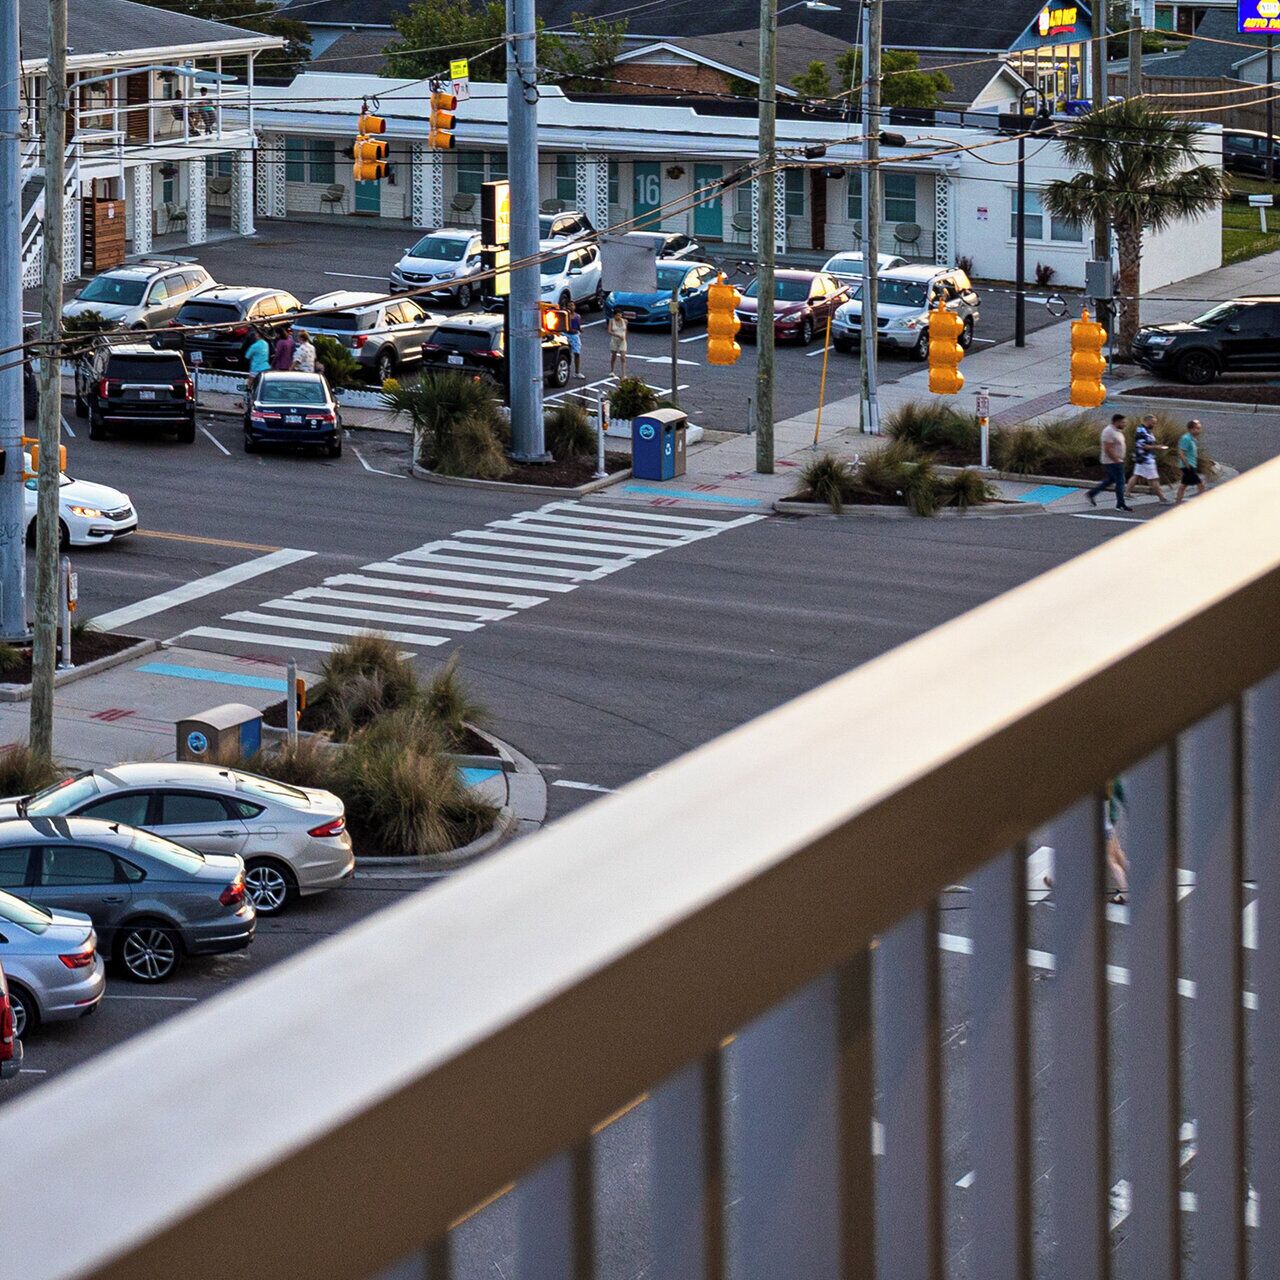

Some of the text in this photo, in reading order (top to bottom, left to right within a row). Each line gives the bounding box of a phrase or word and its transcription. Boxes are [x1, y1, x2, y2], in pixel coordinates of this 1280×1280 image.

[1243, 17, 1268, 28] AUTO
[636, 174, 660, 206] 16
[696, 178, 718, 209] 17
